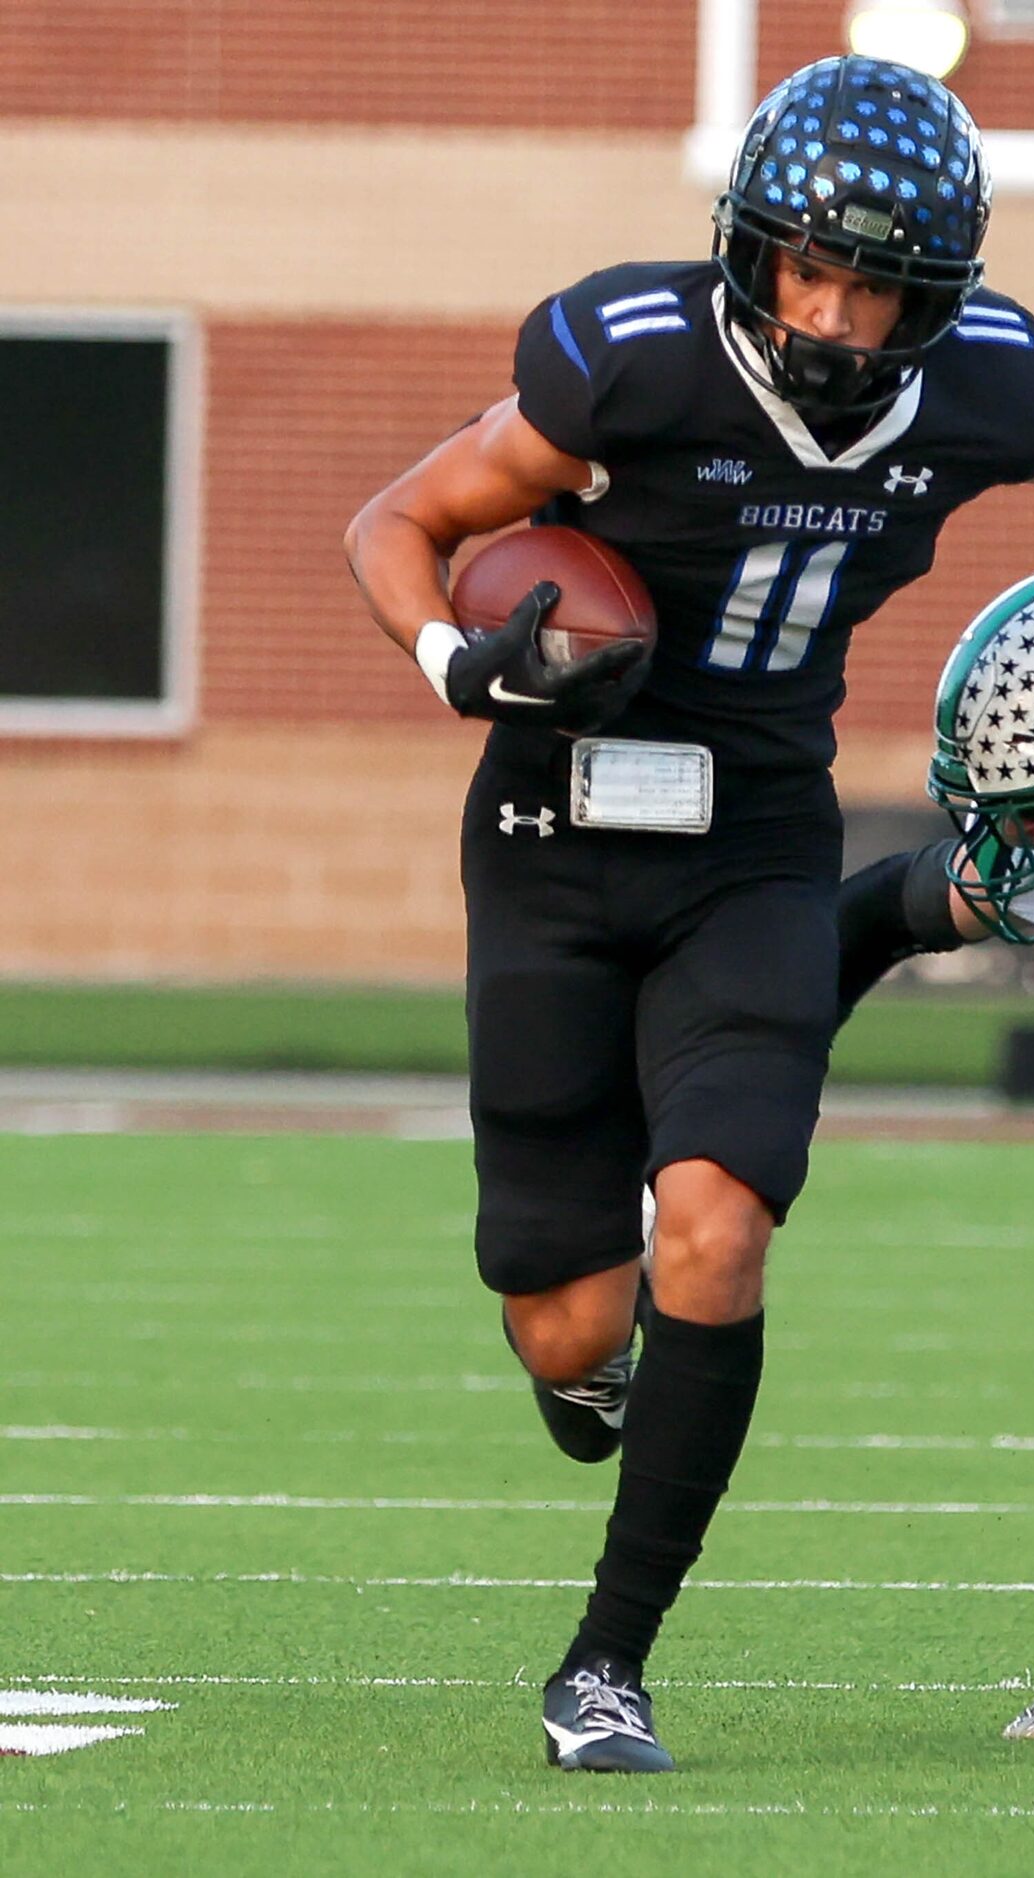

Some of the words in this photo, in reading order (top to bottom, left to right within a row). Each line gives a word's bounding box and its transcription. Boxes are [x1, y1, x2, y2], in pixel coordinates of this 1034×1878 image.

[597, 289, 690, 342] 11
[956, 304, 1033, 347] 11
[740, 504, 888, 532] BOBCATS
[704, 539, 854, 673] 11
